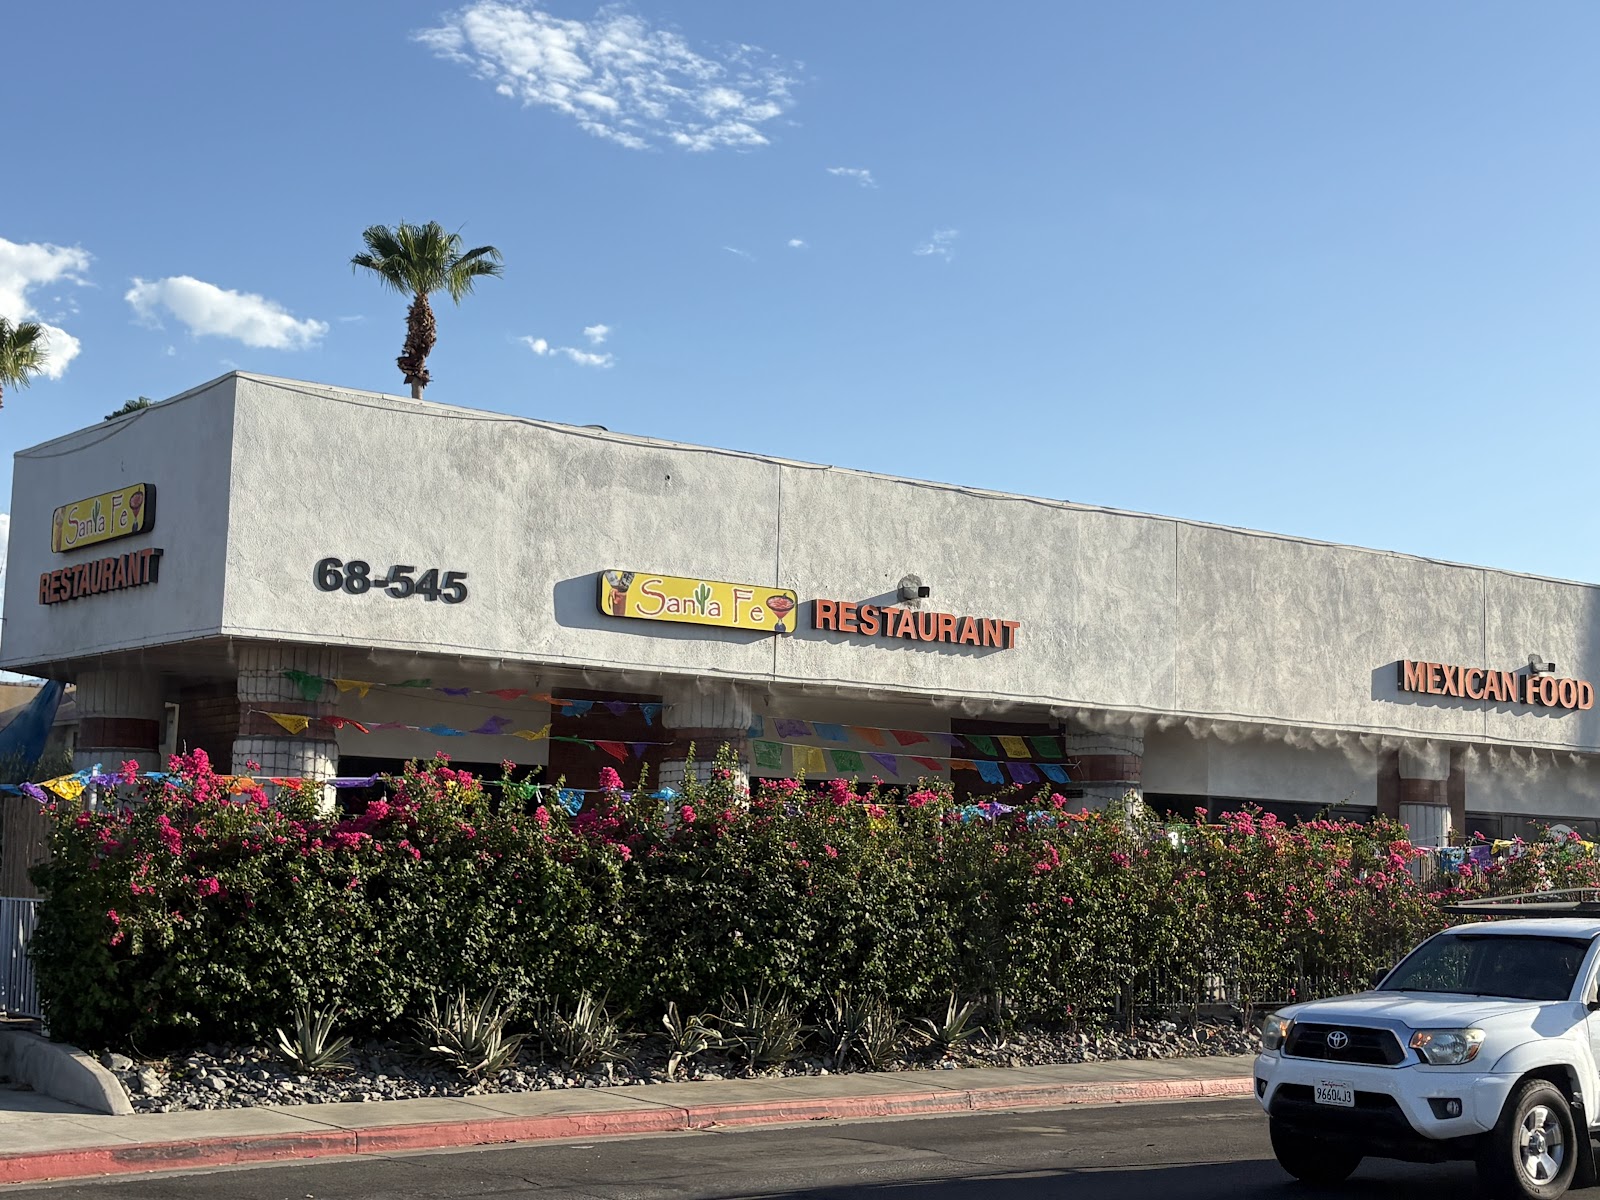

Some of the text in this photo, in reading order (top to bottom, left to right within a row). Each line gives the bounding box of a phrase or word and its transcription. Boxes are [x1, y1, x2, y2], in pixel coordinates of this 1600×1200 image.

[65, 493, 128, 545] Santa Fe
[39, 547, 163, 605] RESTAURANT
[313, 557, 468, 604] 68-545
[635, 578, 721, 617] Santa
[732, 587, 765, 623] Fe
[811, 598, 1021, 649] RESTAURANT
[1398, 660, 1595, 710] MEXICAN FOOD
[1316, 1087, 1352, 1102] 96604J3
